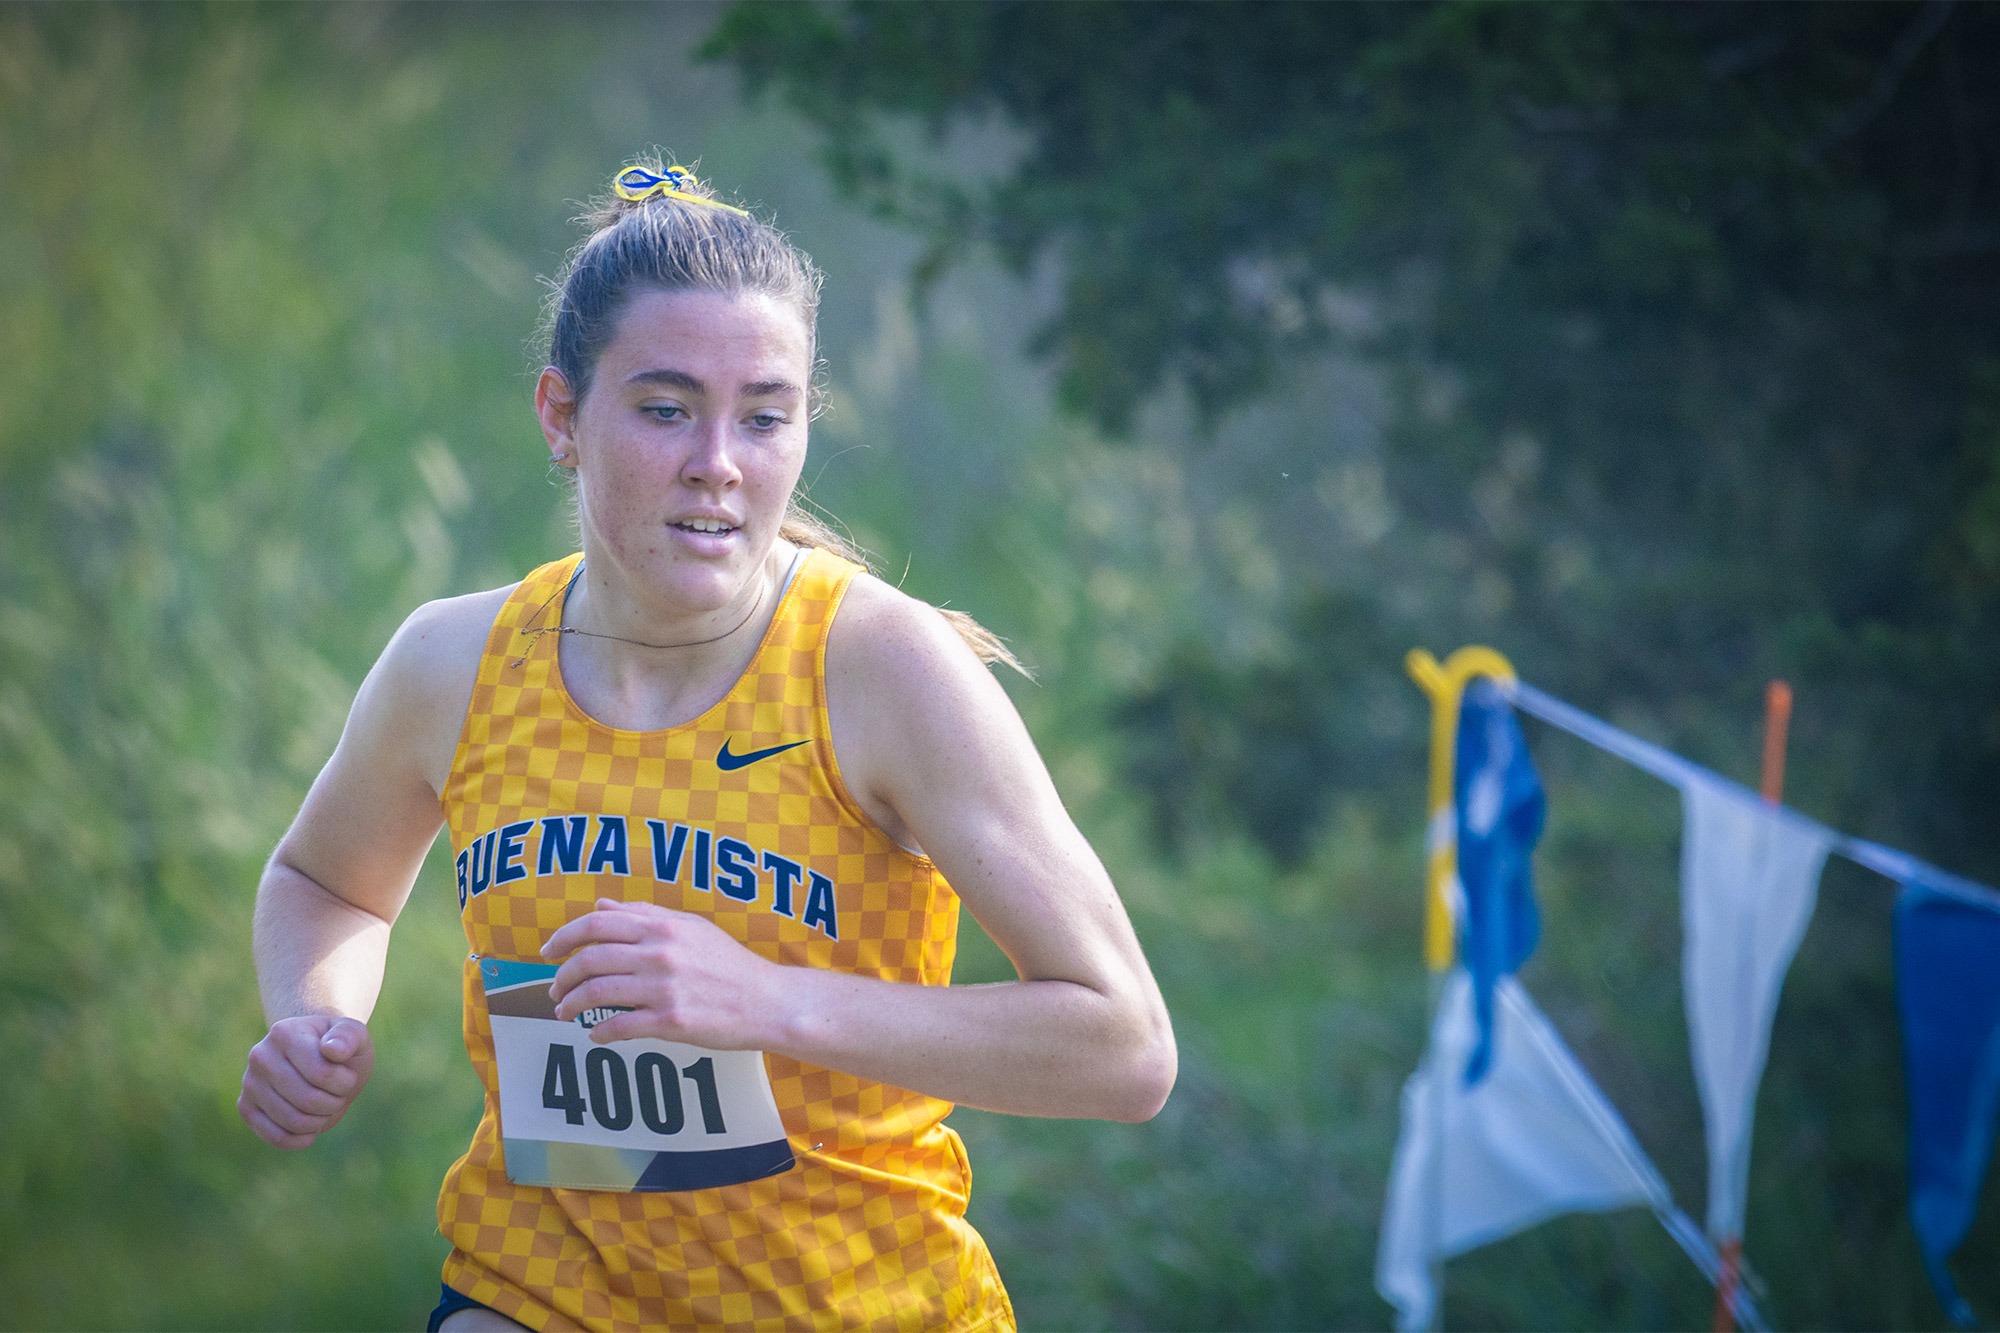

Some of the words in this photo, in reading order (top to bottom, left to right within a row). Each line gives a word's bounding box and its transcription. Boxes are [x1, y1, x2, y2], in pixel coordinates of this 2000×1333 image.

[455, 815, 631, 914] BUENA
[645, 819, 840, 943] VISTA
[542, 1043, 727, 1135] 4001
